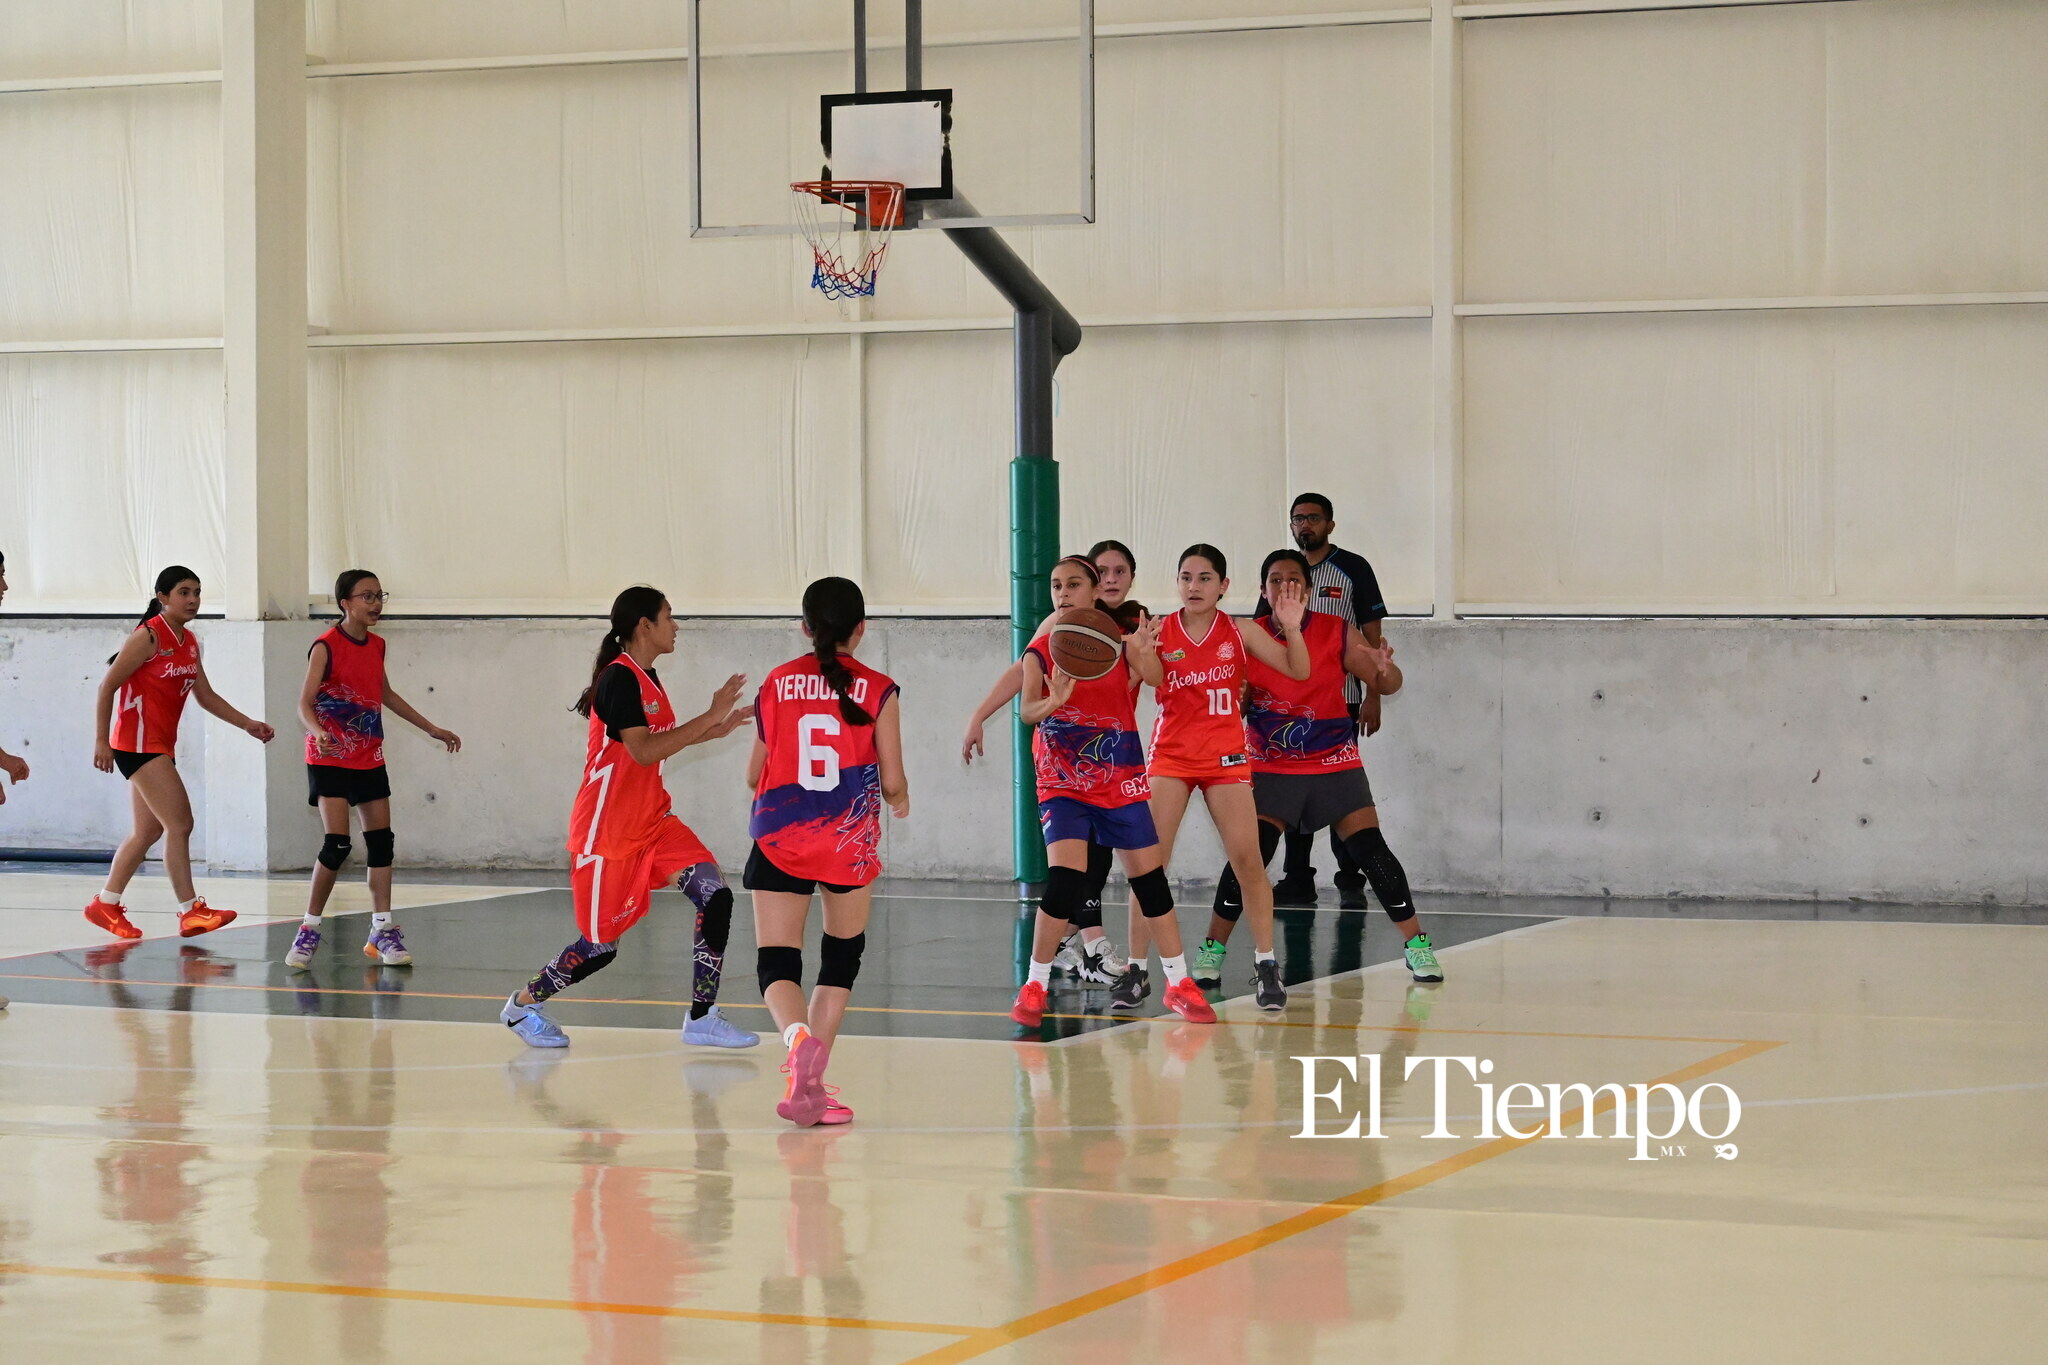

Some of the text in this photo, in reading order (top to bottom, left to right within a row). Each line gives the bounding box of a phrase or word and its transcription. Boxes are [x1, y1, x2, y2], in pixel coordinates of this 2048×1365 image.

[774, 674, 868, 704] VERDUO
[1167, 663, 1236, 693] Acero1080
[1206, 688, 1233, 716] 10
[798, 713, 841, 792] 6
